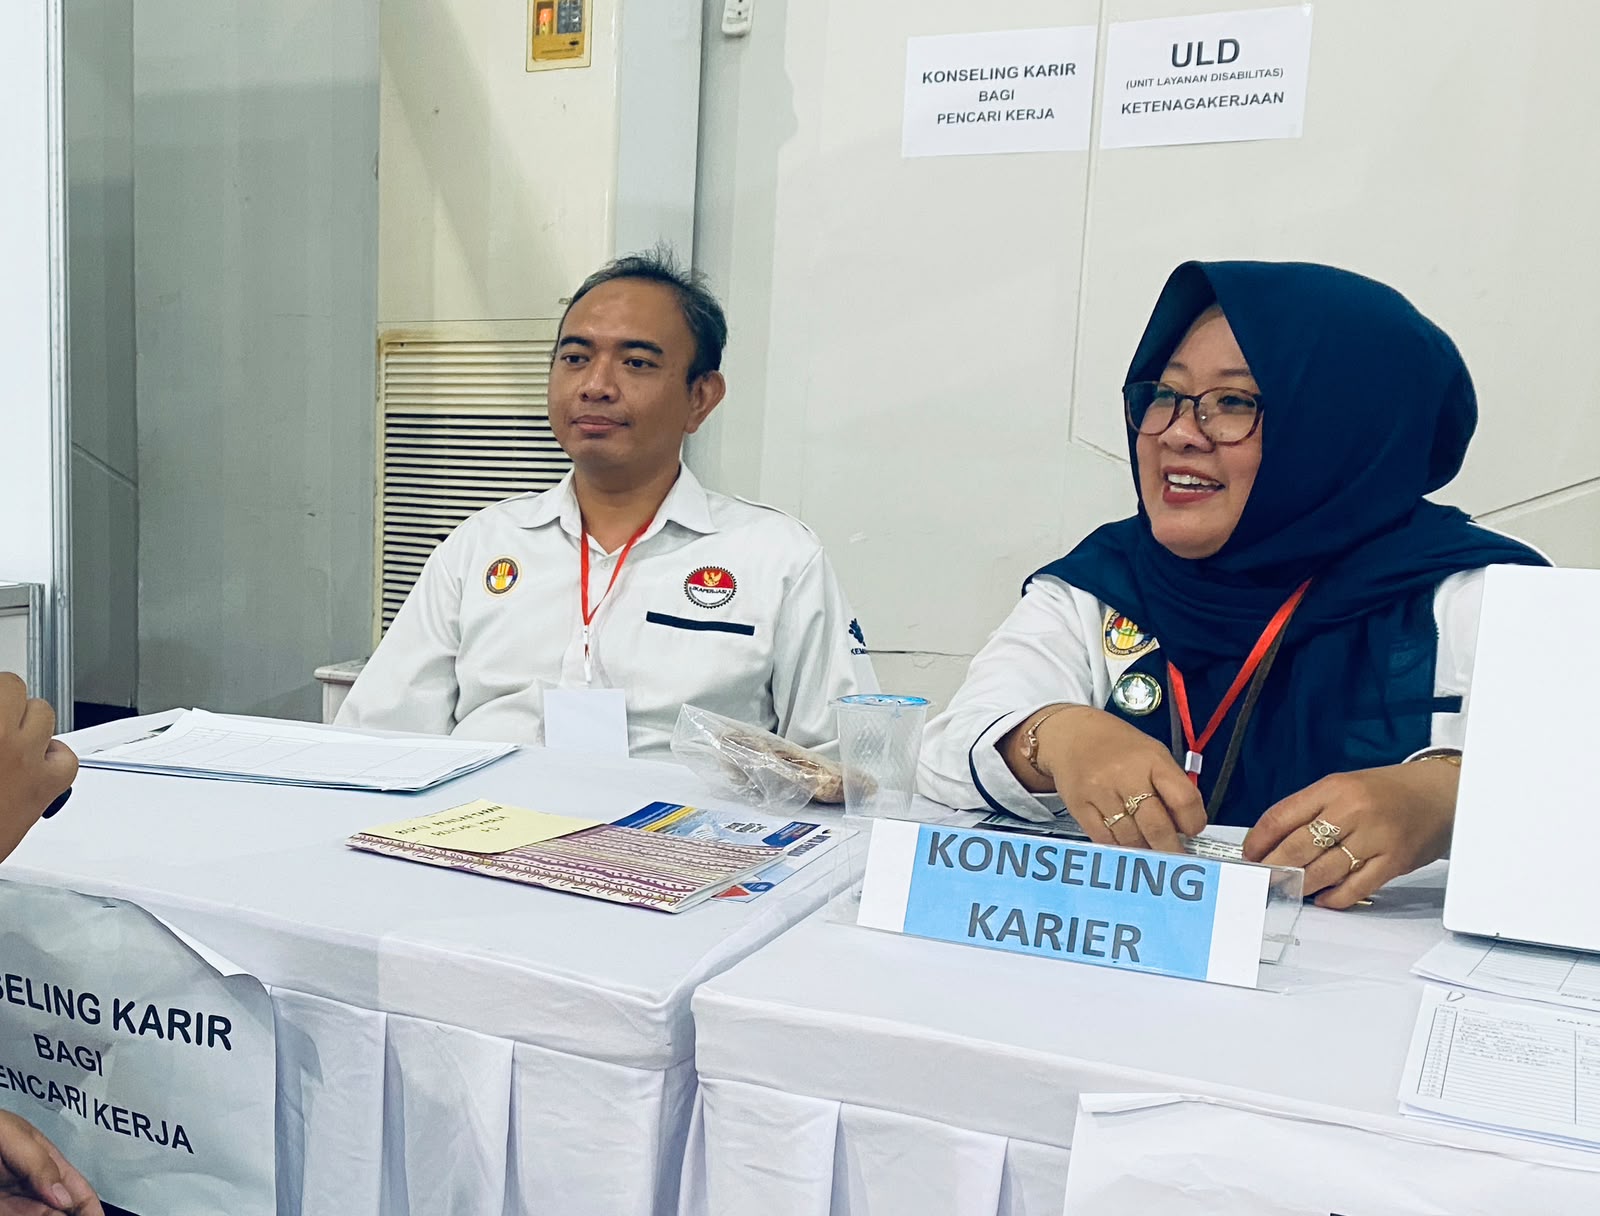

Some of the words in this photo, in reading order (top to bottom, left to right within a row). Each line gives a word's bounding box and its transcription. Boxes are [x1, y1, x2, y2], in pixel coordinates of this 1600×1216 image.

[1172, 39, 1239, 68] ULD
[923, 66, 1018, 84] KONSELING
[1024, 62, 1075, 78] KARIR
[1126, 79, 1154, 90] (UNIT
[1157, 75, 1208, 87] LAYANAN
[1211, 68, 1283, 82] DISABILITAS)
[978, 89, 1015, 103] BAGI
[1121, 91, 1285, 115] KETENAGAKERJAAN
[937, 110, 1001, 125] PENCARI
[1005, 108, 1055, 121] KERJA
[927, 831, 1206, 902] KONSELING
[967, 902, 1142, 963] KARIER
[0, 973, 101, 1025] ELING
[112, 998, 232, 1051] KARIR
[33, 1033, 103, 1077] BAGI
[94, 1098, 195, 1154] KERJA
